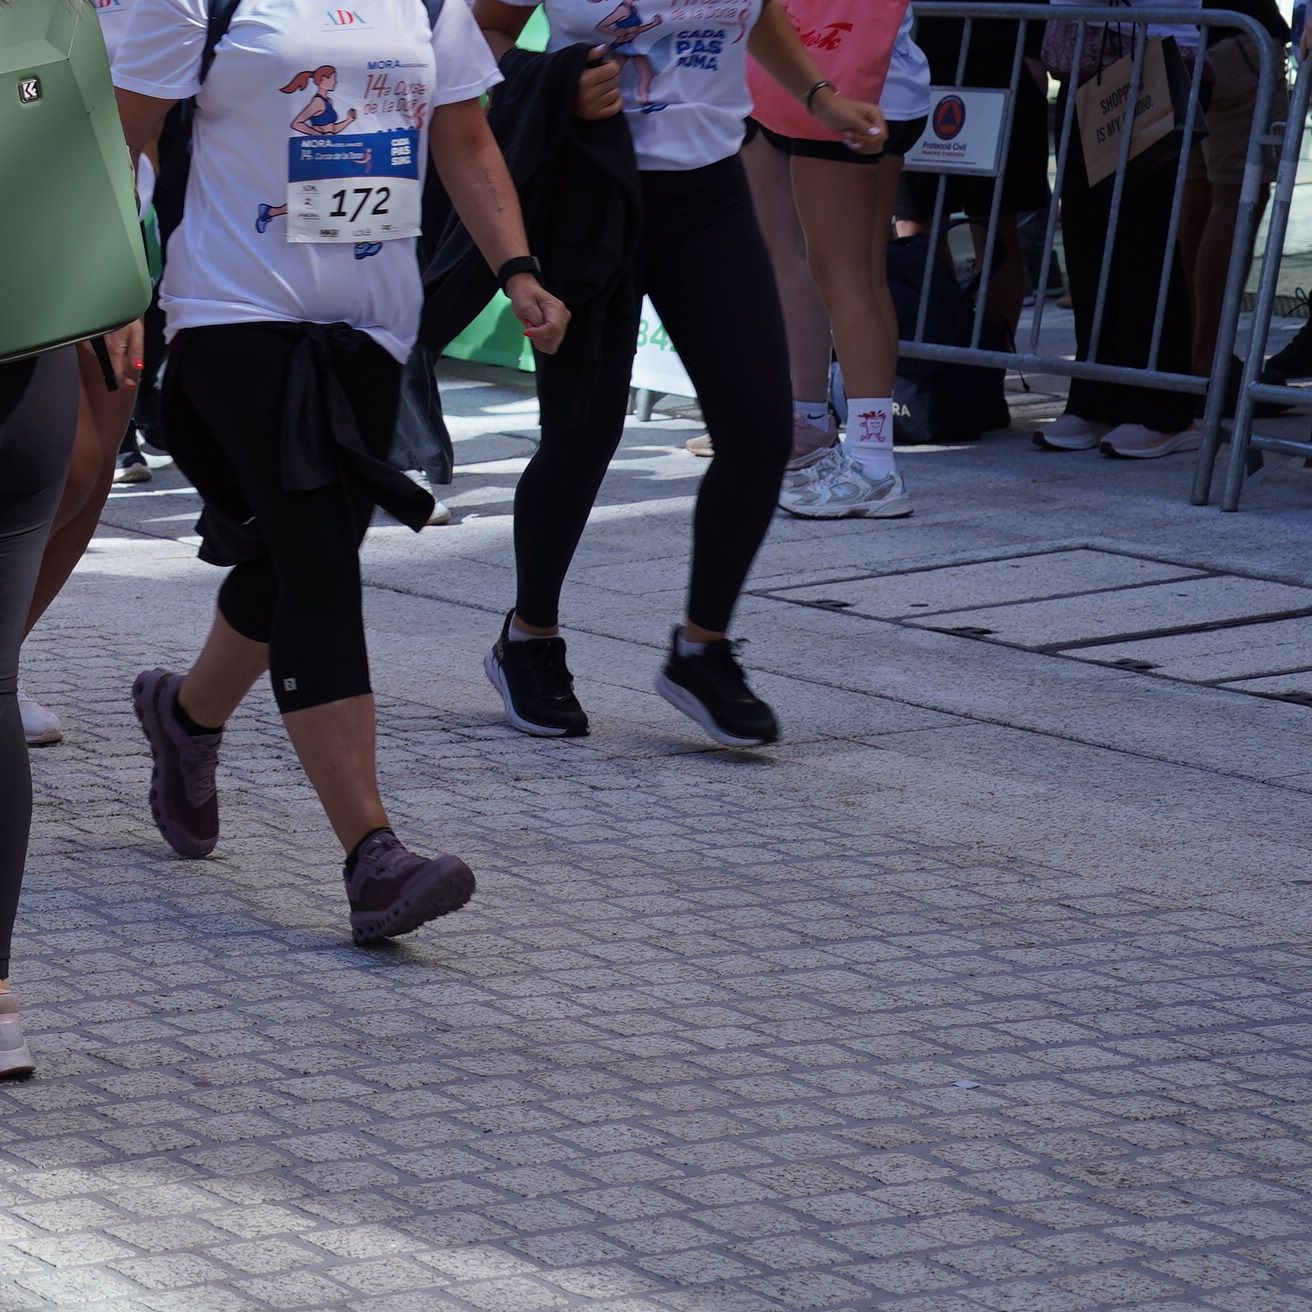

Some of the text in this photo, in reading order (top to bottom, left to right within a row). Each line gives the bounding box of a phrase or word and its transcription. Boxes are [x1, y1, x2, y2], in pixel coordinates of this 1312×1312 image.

[676, 29, 727, 40] CADA
[675, 39, 724, 55] PAS
[367, 59, 401, 70] MORA
[329, 186, 391, 223] 172
[893, 401, 912, 418] RA
